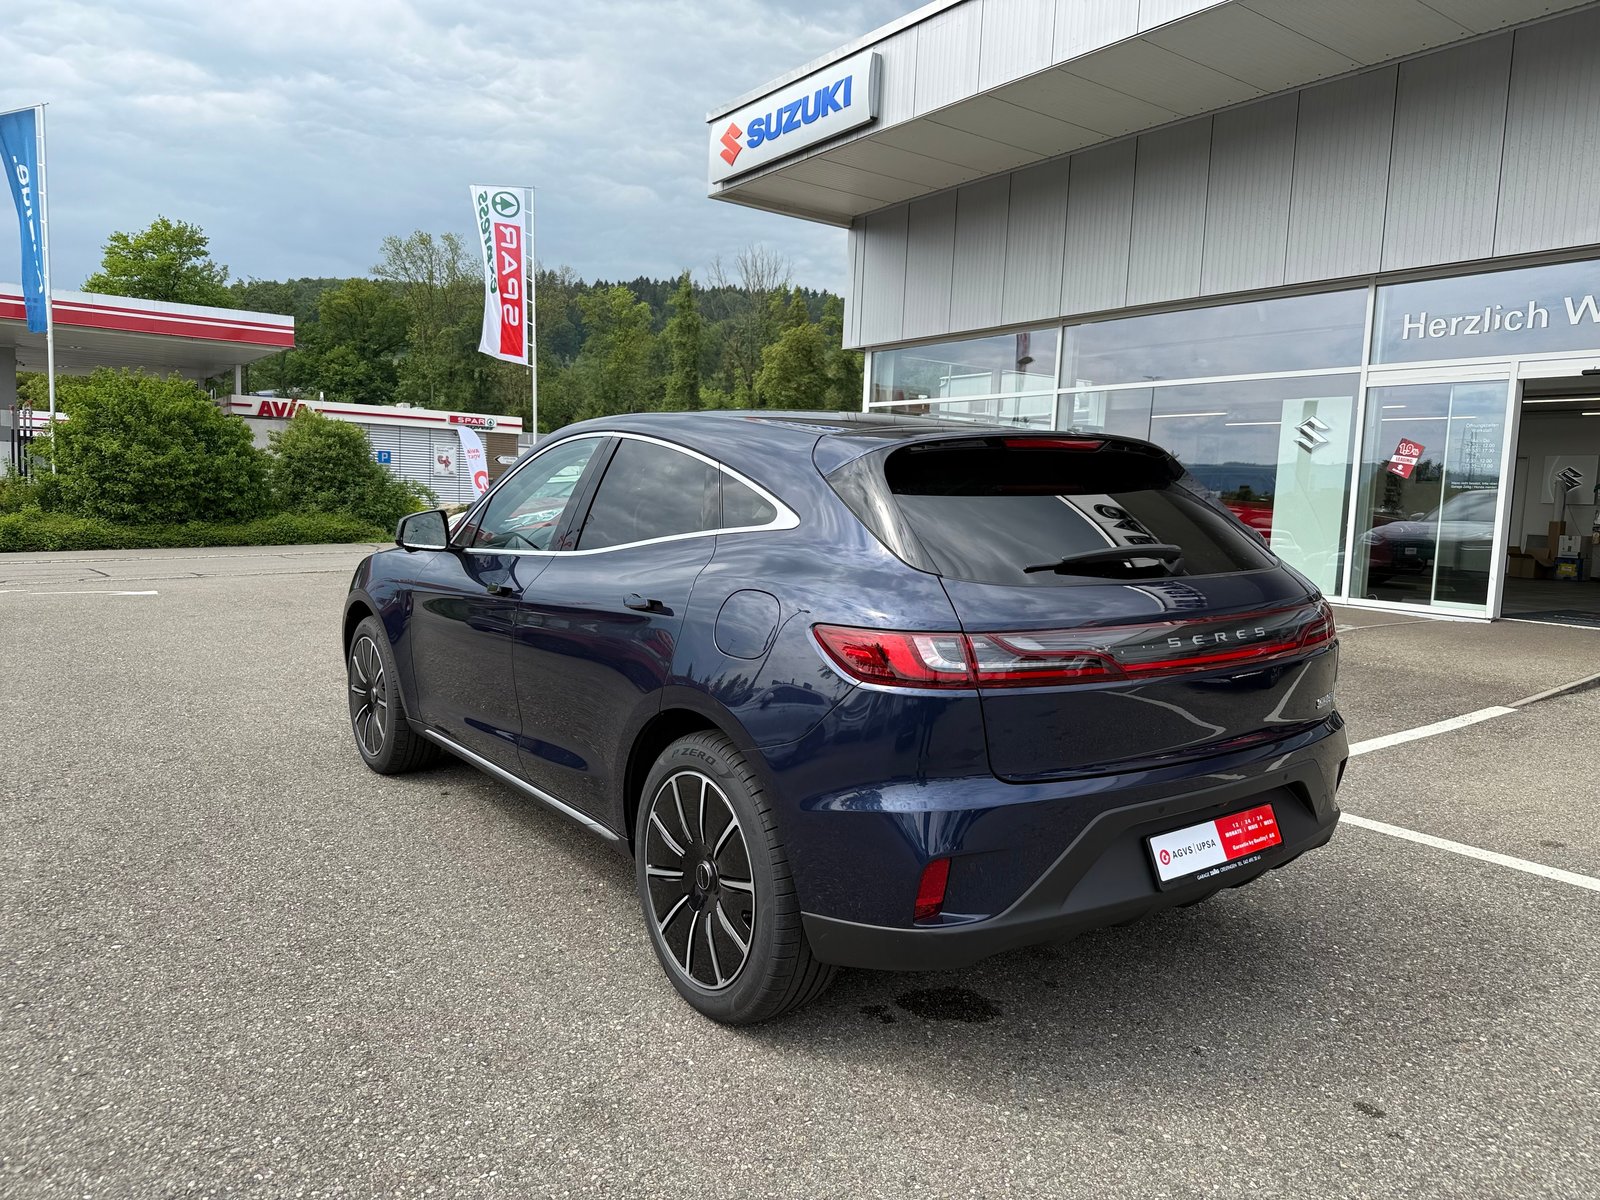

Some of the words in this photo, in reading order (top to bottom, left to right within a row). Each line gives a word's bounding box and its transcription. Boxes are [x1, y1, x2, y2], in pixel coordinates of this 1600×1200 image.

[747, 75, 852, 149] SUZUKI
[1402, 300, 1550, 340] Herzlich
[457, 416, 485, 425] SPAR
[381, 452, 388, 462] P
[1168, 627, 1265, 648] SERES
[671, 748, 680, 758] P
[680, 747, 716, 766] ZERO
